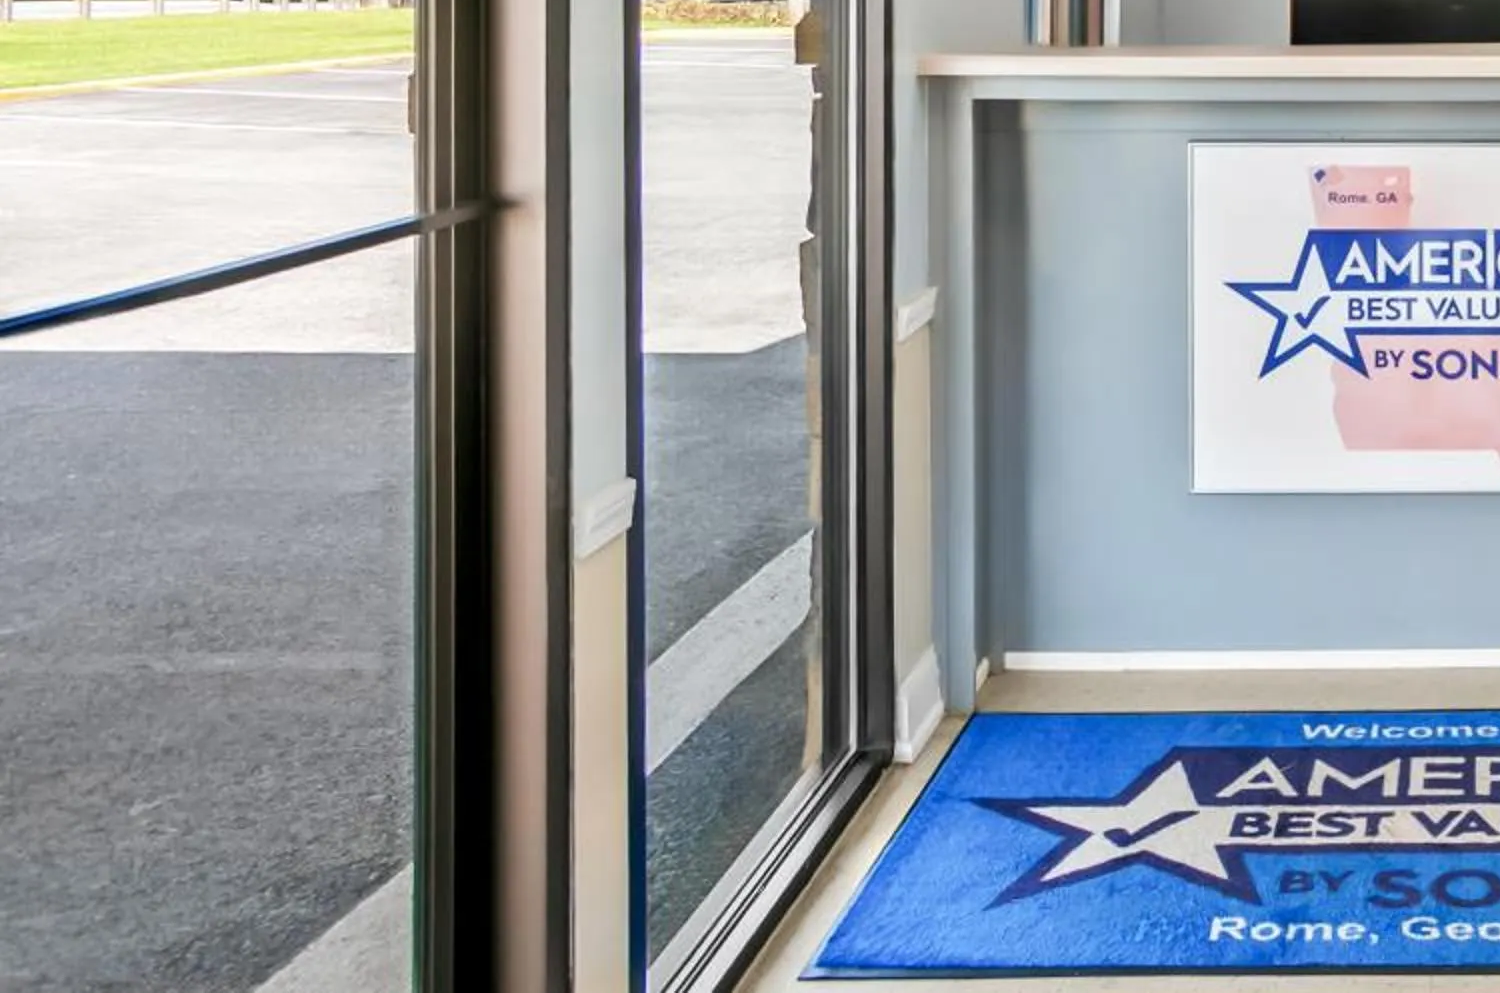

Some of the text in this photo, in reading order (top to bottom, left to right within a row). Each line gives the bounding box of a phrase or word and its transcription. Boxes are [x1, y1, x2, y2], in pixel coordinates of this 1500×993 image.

[1375, 191, 1398, 204] GA
[1347, 297, 1417, 321] BEST
[1374, 350, 1405, 368] BY
[1302, 722, 1500, 740] Welcome
[1228, 810, 1396, 838] BEST
[1279, 870, 1354, 894] BY
[1208, 916, 1379, 945] Rome,
